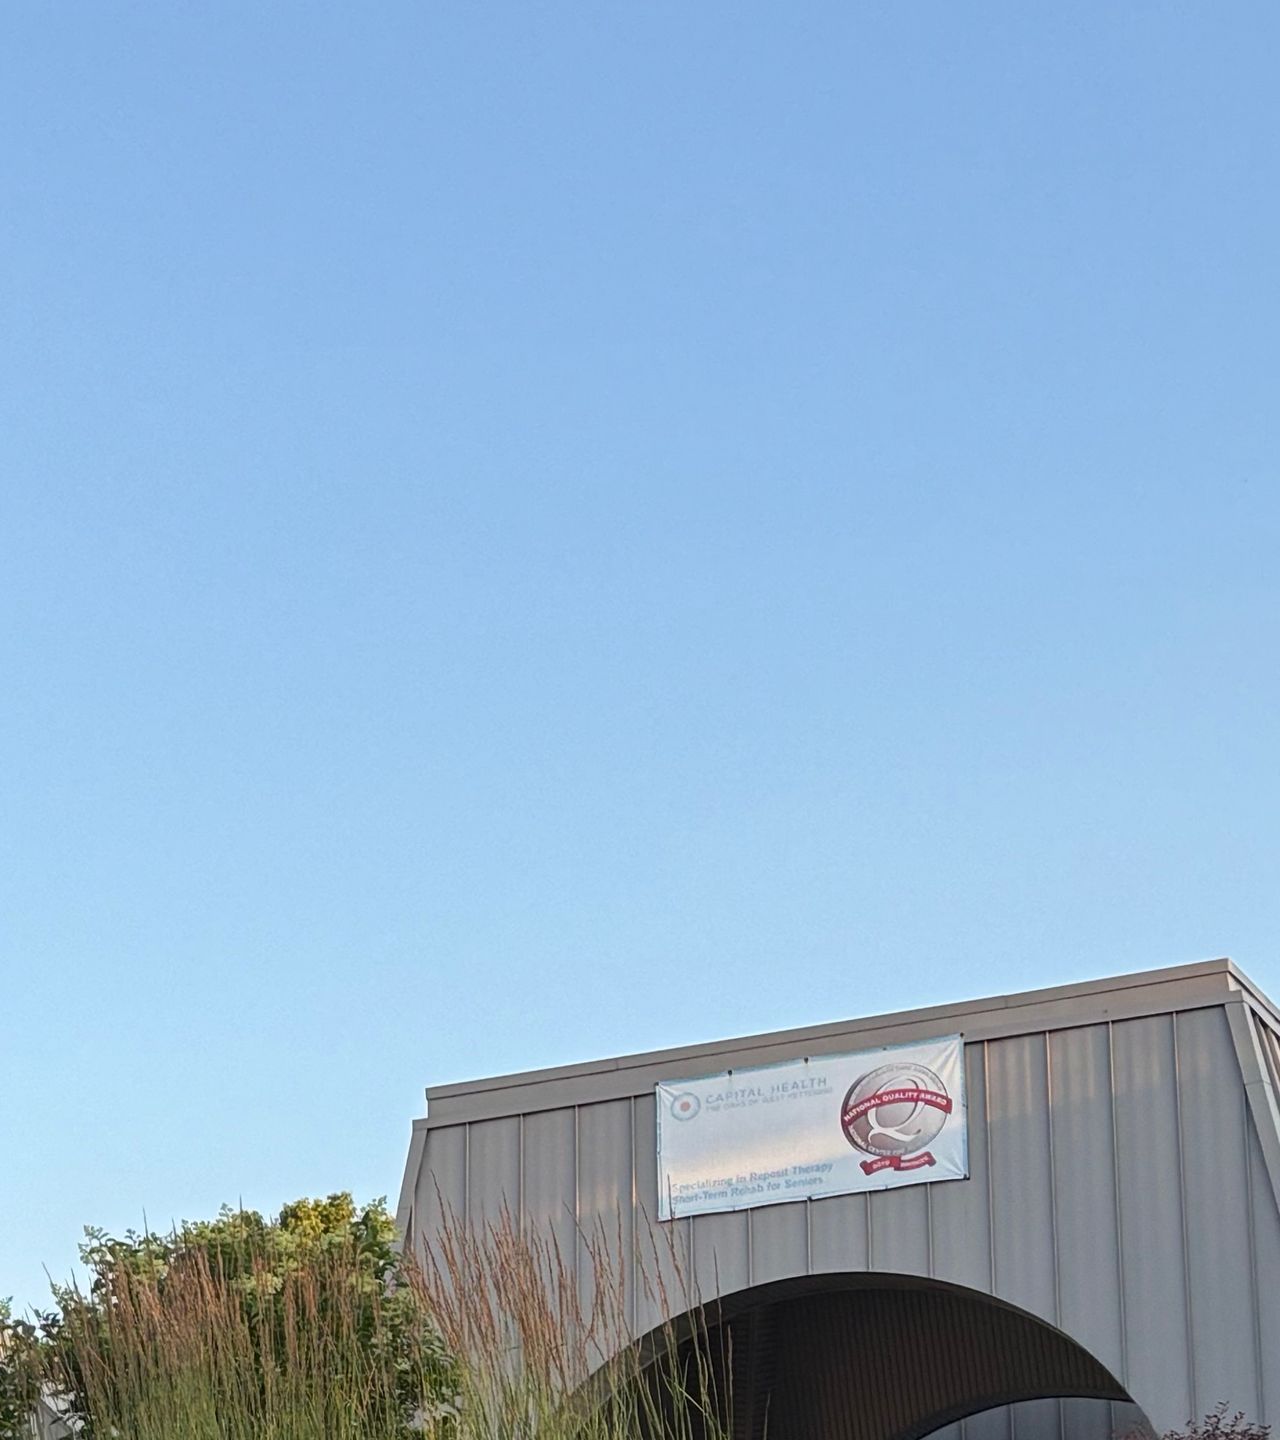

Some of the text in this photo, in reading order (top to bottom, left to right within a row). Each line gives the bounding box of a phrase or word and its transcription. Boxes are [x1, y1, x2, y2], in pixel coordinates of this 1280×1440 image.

[705, 1077, 827, 1105] CAPITAL HEALTH
[843, 1091, 947, 1122] NATIONAL QUALITY AWARD
[672, 1176, 734, 1193] Specializing
[736, 1174, 747, 1184] in
[792, 1162, 834, 1175] Therapy
[672, 1176, 824, 1205] Short-Term Rehab for Seniors
